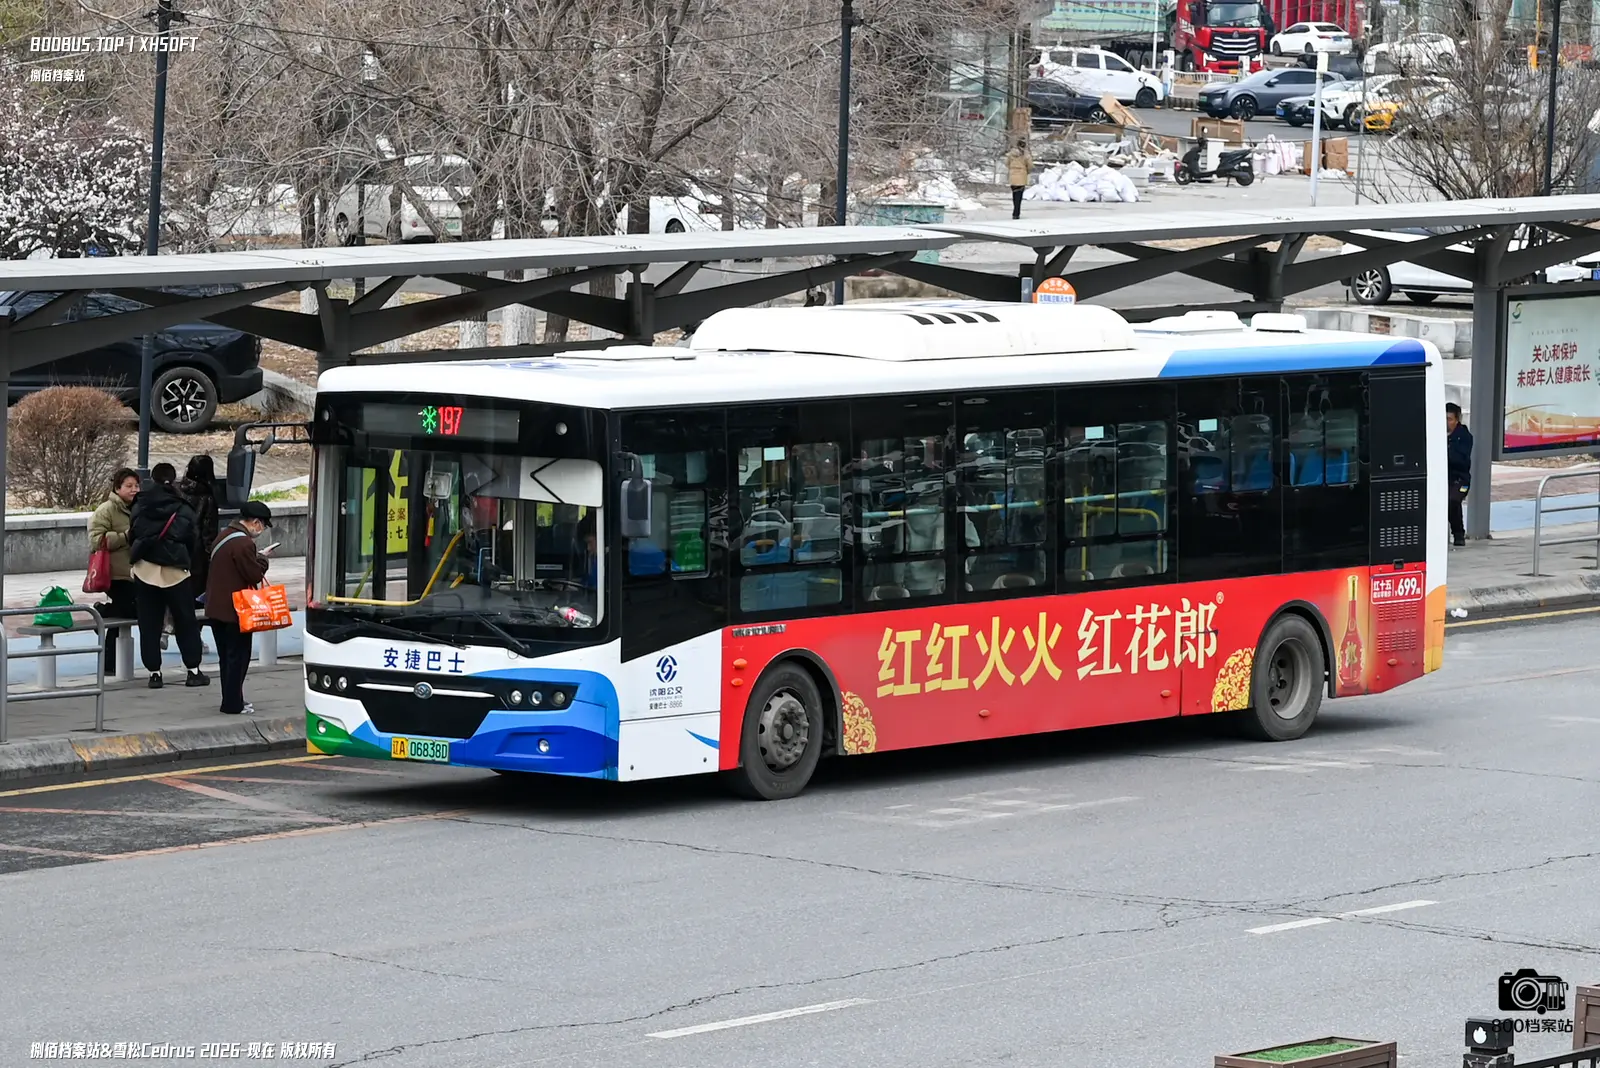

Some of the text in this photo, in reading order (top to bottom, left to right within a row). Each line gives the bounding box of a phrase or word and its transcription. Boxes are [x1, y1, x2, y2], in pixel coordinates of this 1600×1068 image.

[1532, 342, 1578, 363] 关心和保护
[1516, 364, 1591, 388] 未成年人健康成长
[438, 406, 464, 435] 197
[877, 597, 1219, 698] 红红火火 红花郎
[383, 647, 465, 673] 安捷巴士
[649, 686, 683, 696] 沈阳公交
[410, 741, 448, 759] 06838D
